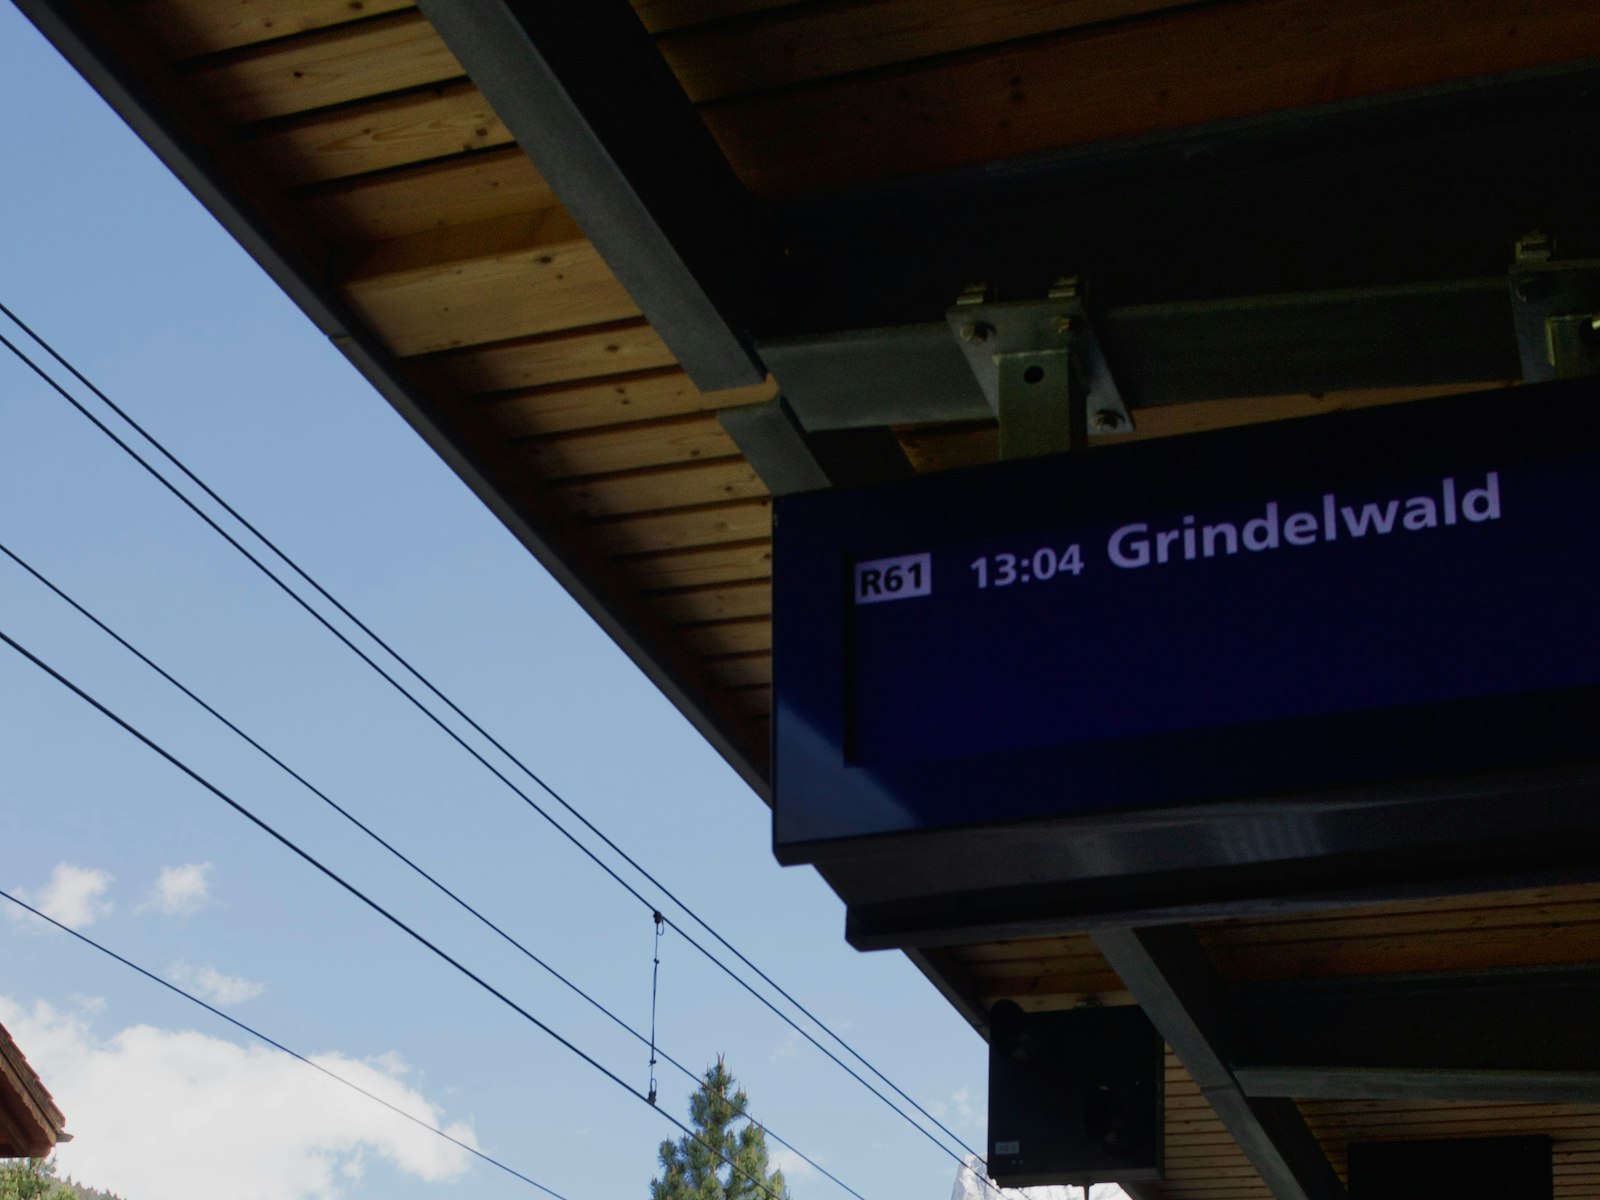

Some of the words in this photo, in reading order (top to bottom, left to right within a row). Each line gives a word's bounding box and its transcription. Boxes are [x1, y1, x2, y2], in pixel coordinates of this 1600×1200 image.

[860, 561, 924, 596] R61
[971, 544, 1084, 588] 13:04
[1107, 472, 1502, 568] Grindelwald
